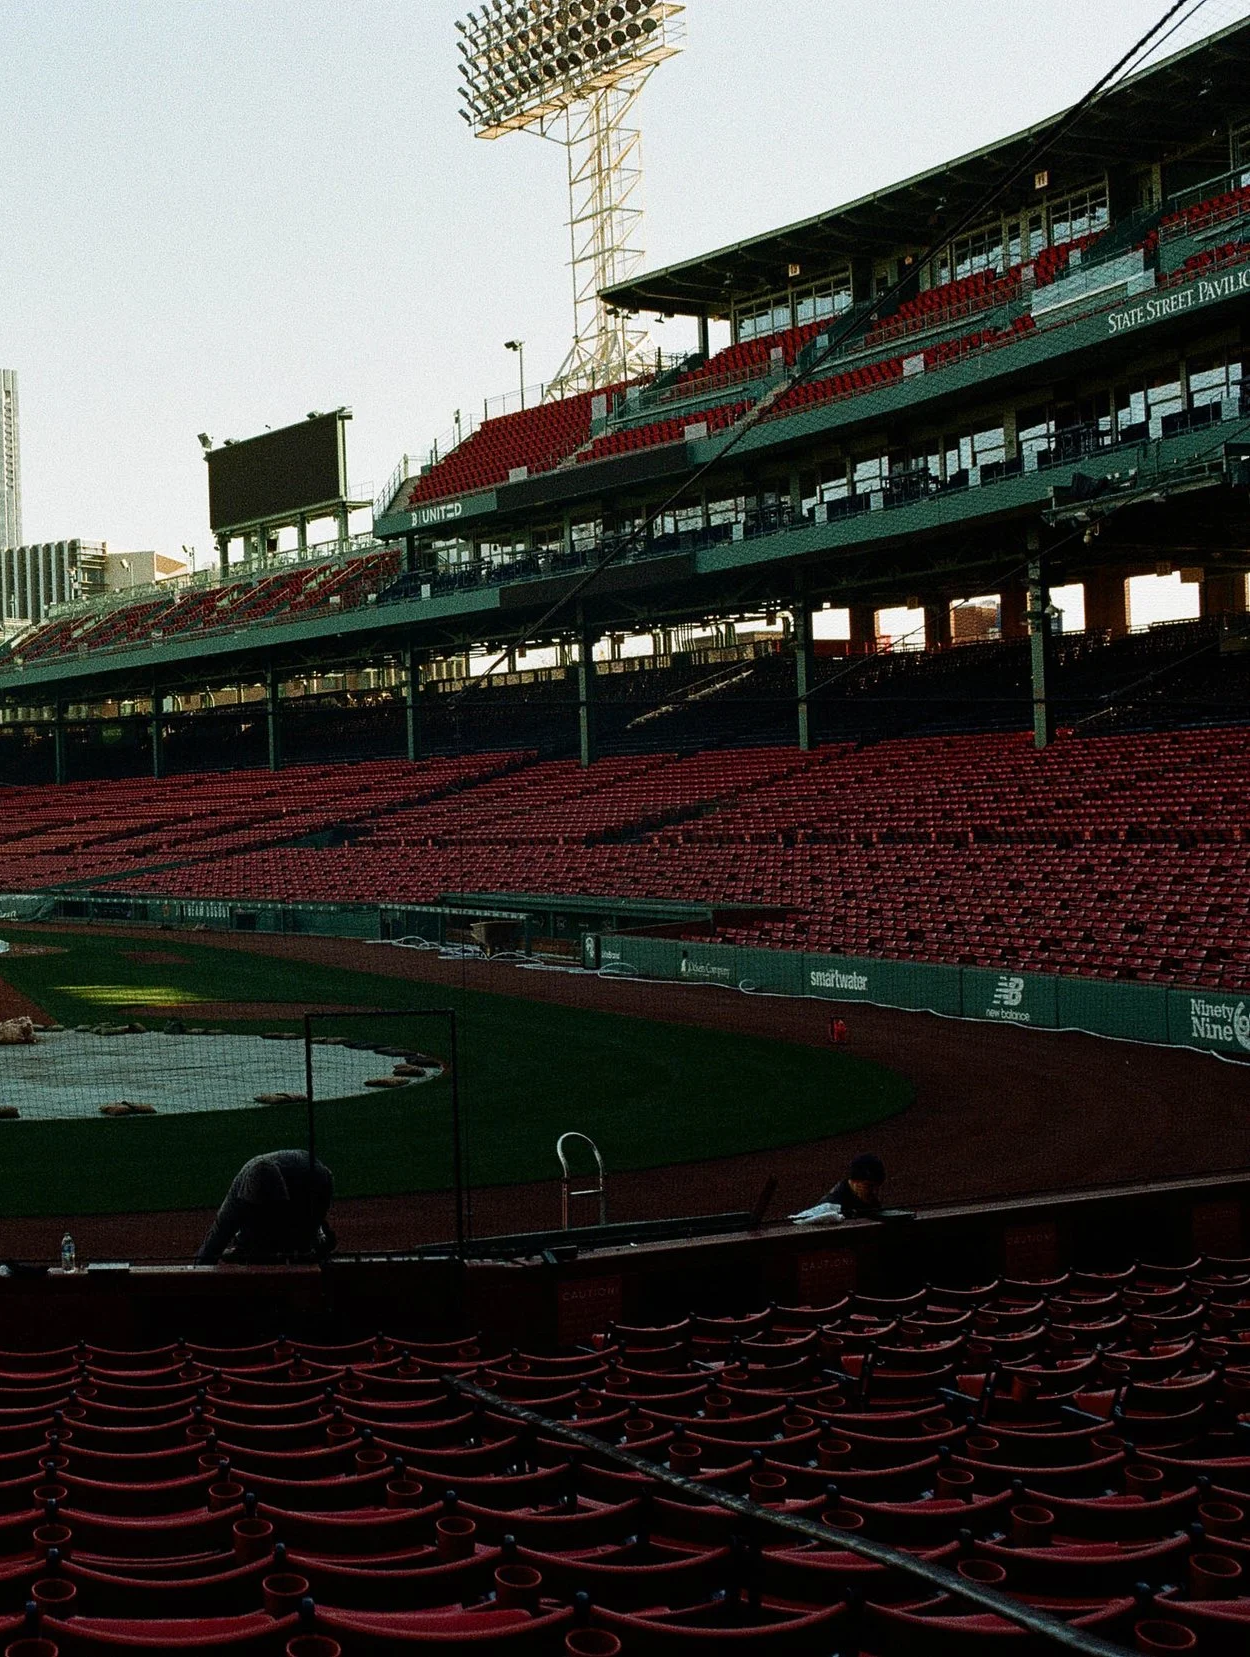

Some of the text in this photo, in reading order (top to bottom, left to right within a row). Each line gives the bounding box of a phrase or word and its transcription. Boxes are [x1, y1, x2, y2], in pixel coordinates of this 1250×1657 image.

[1108, 306, 1145, 333] STATE
[810, 969, 869, 991] smartwater
[1191, 998, 1234, 1022] Ninety
[1191, 1016, 1233, 1041] Nine
